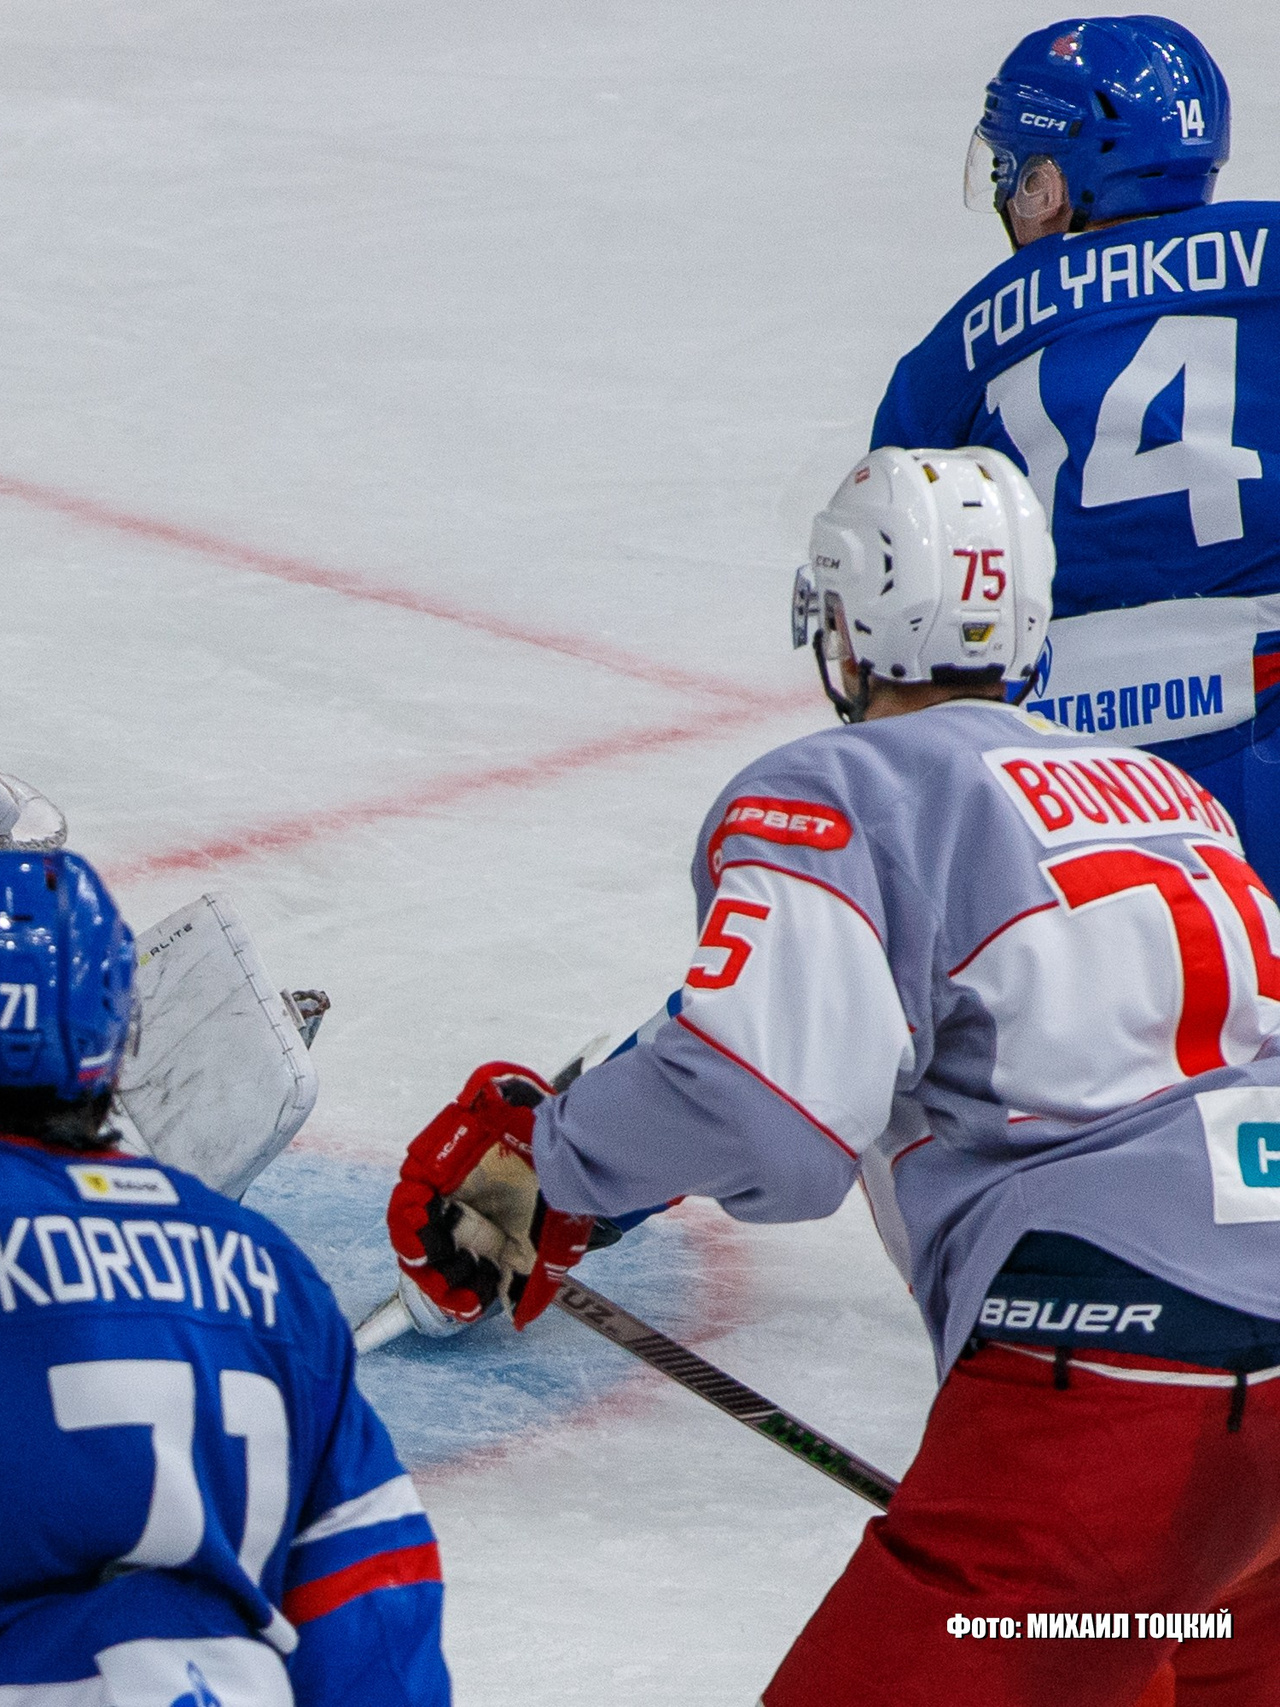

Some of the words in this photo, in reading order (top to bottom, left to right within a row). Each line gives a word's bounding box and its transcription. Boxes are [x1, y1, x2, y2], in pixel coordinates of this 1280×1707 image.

[1020, 112, 1067, 132] CCM
[1176, 98, 1205, 138] 14
[963, 228, 1269, 371] POLYAKOV
[986, 315, 1263, 547] 14
[953, 549, 1007, 602] 75
[1058, 674, 1224, 733] ГАЗПРОМ
[48, 1359, 300, 1655] 71
